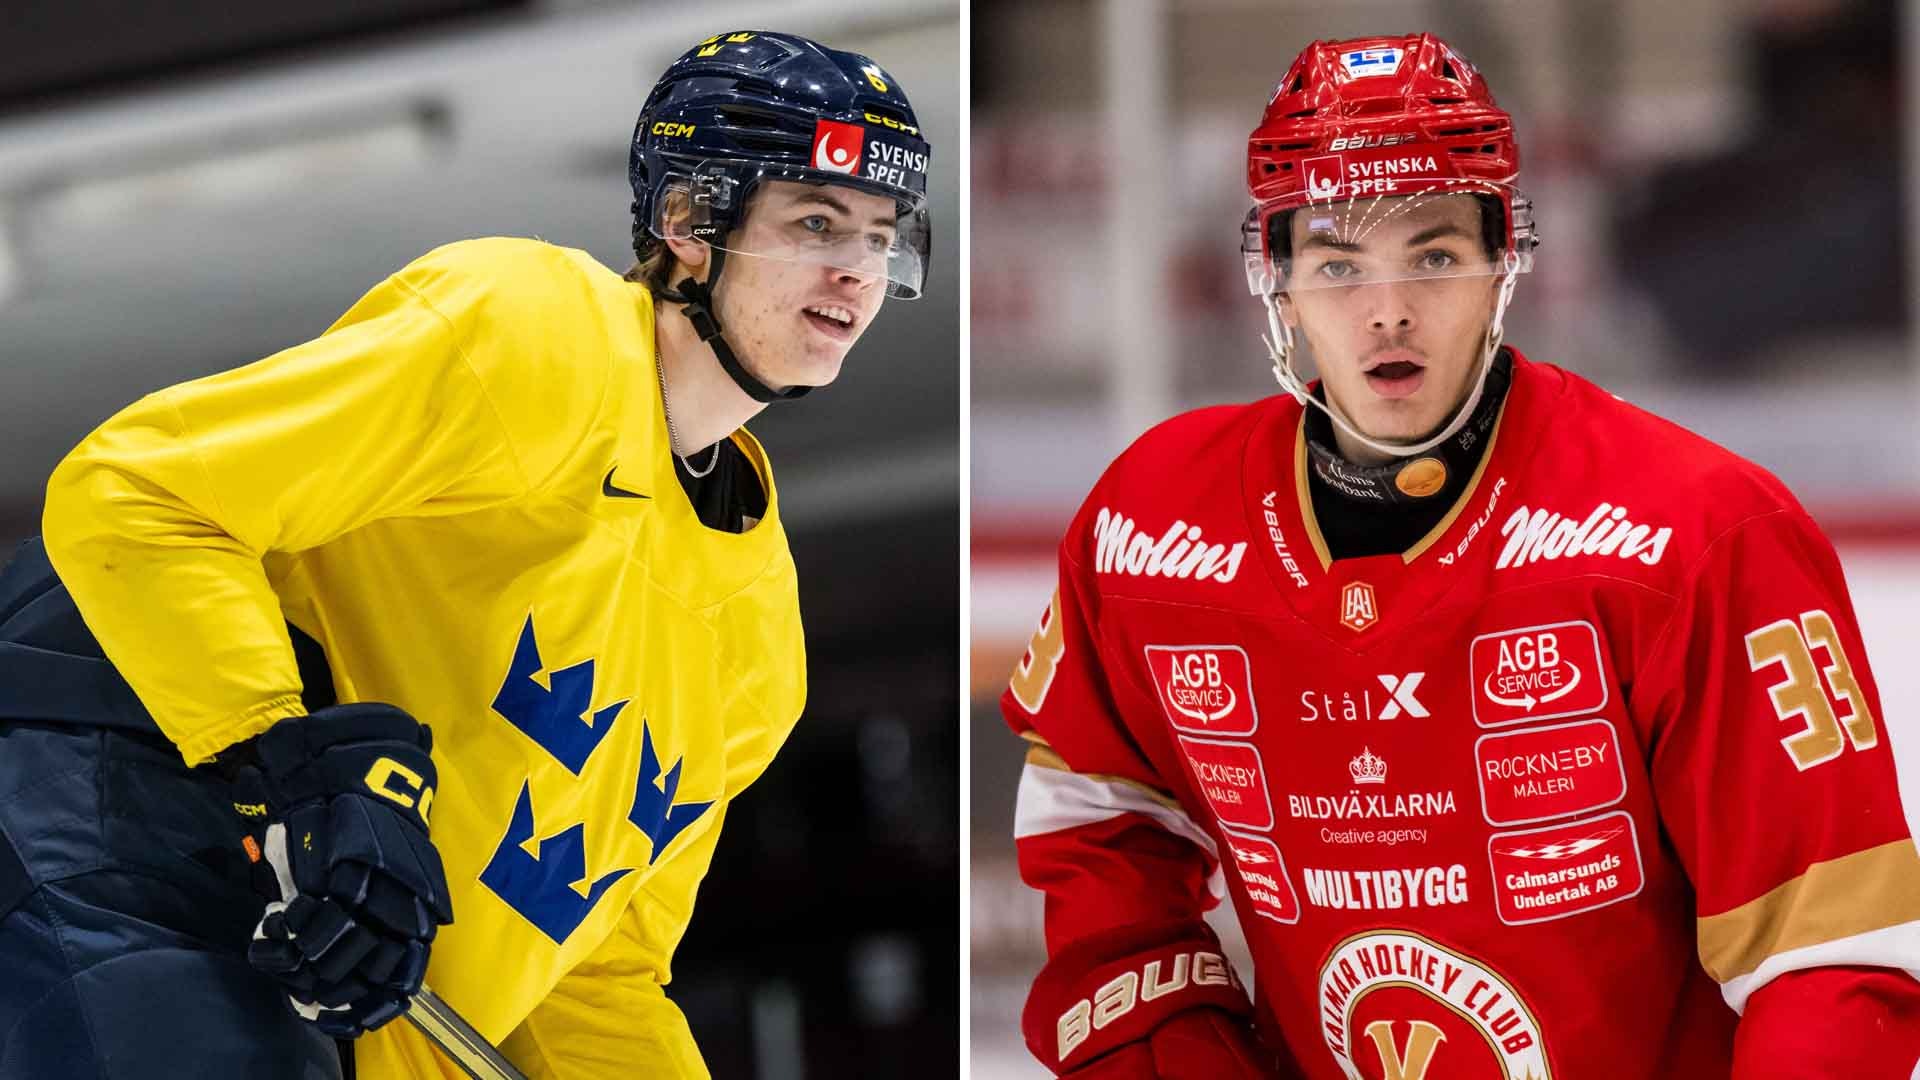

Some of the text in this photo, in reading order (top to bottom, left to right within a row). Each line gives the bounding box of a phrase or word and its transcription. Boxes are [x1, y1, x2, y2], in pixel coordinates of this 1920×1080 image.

[652, 122, 697, 138] CCM
[866, 162, 907, 189] SPEL
[1348, 156, 1438, 178] SVENSKA
[1349, 177, 1398, 197] SPEL
[1457, 477, 1507, 557] BAUER
[1094, 507, 1248, 583] Molins
[1264, 509, 1308, 588] BAUER
[1496, 502, 1673, 570] Molins
[1171, 653, 1222, 688] AGB
[1497, 633, 1560, 675] AGB
[1175, 689, 1225, 707] SERVICE
[1497, 669, 1563, 695] SERVICE
[1744, 609, 1878, 772] 33
[1486, 742, 1607, 780] ROCKNEBY
[1288, 790, 1456, 819] BILDVÄXLARNA
[1513, 776, 1576, 799] MÅLERI
[234, 802, 267, 816] CCM
[1321, 827, 1427, 845] Creative agency
[1303, 864, 1469, 910] MULTIBYGG
[1506, 853, 1621, 891] Calmarsunds
[1513, 875, 1619, 910] Undertak AB
[1324, 943, 1534, 1060] KALMAR HOCKEY CLUB
